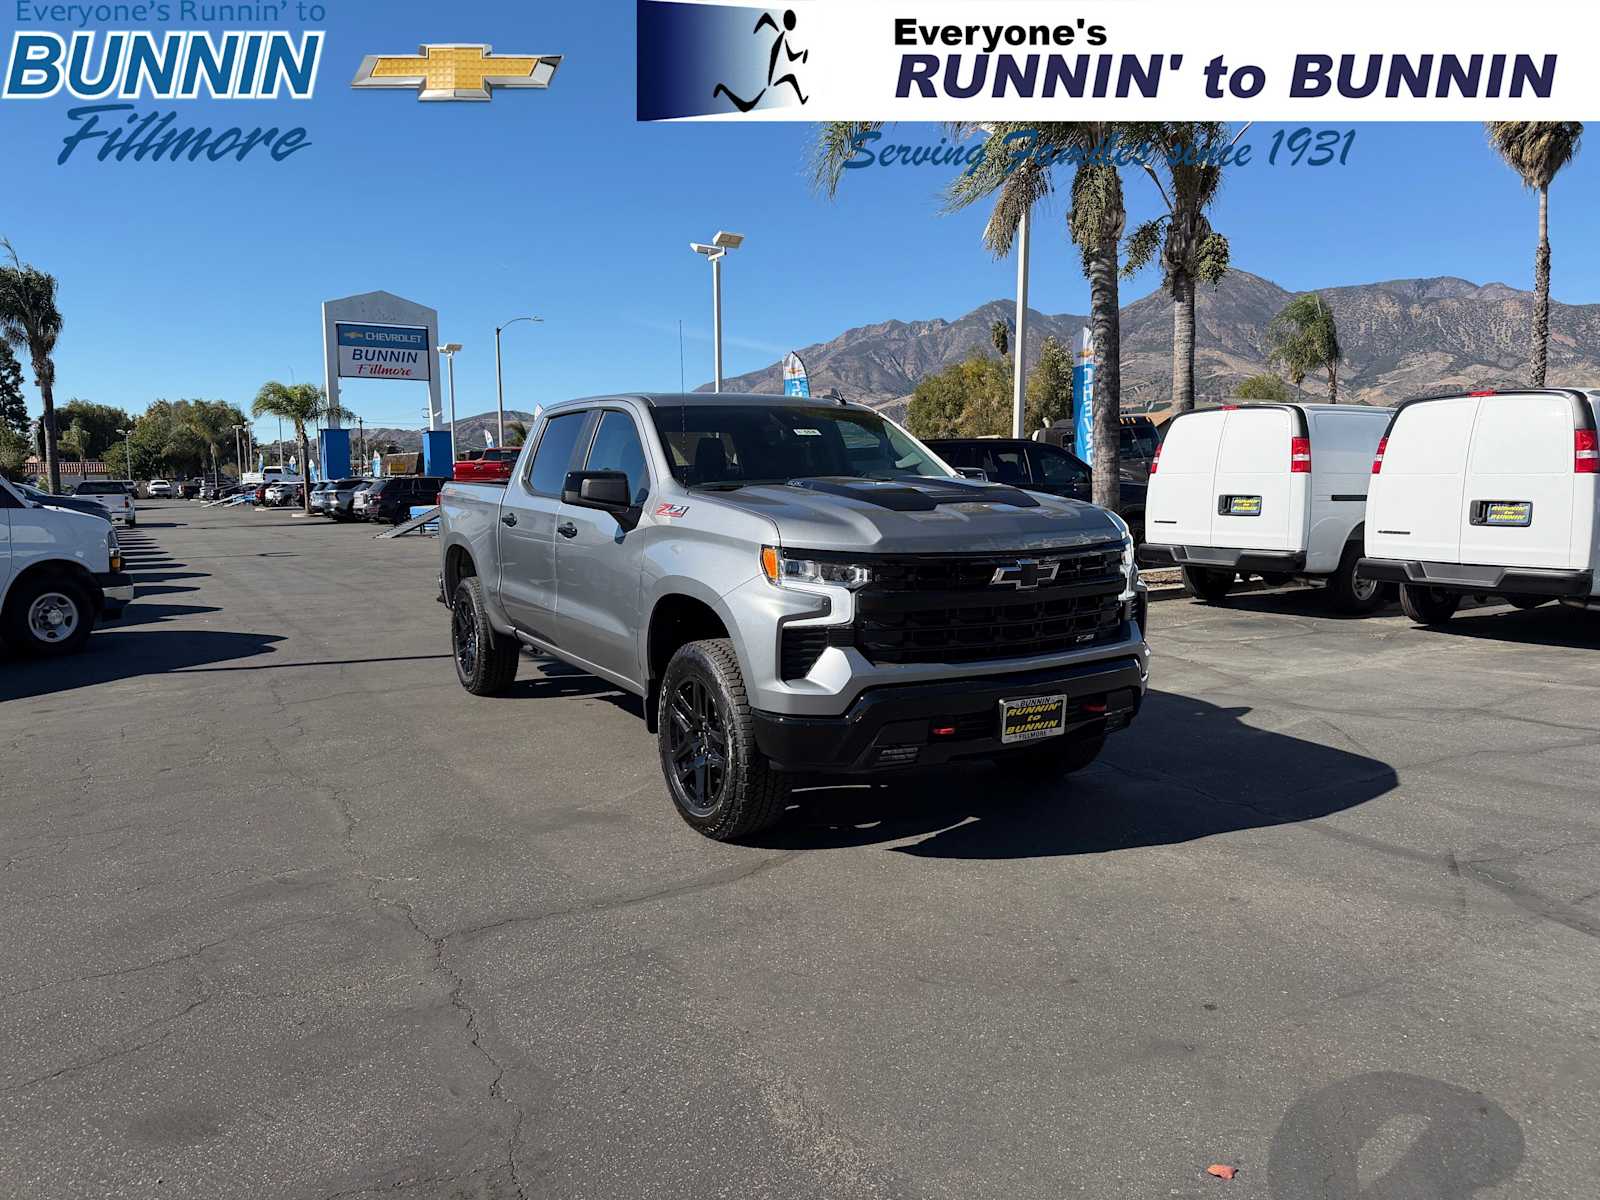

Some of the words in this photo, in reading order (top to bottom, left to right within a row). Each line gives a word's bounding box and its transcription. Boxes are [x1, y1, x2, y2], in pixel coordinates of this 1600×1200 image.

[365, 331, 422, 343] CHEVROLET
[352, 348, 418, 363] BUNNIN
[355, 363, 413, 377] Fillmore
[1027, 714, 1042, 722] to
[1006, 720, 1058, 734] BUNNIN
